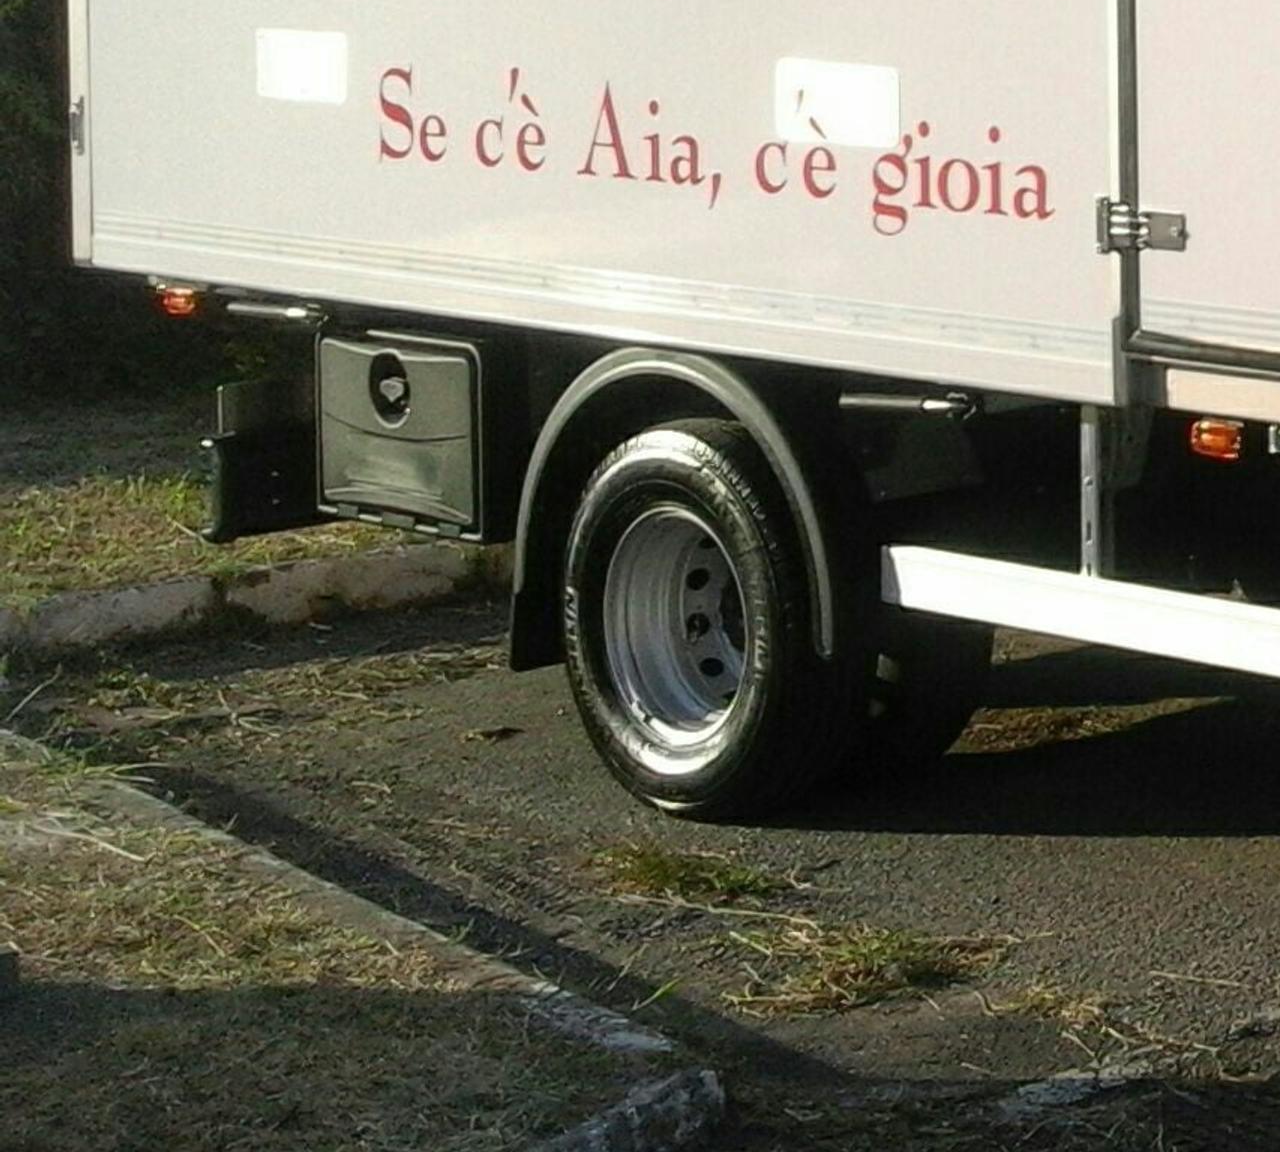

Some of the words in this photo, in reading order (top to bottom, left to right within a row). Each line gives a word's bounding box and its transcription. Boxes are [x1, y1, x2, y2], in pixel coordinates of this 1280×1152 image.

[378, 64, 447, 163] Se
[475, 66, 546, 172] c'è
[576, 80, 722, 210] Aia,
[755, 89, 837, 199] c'è
[872, 120, 1056, 236] gioia
